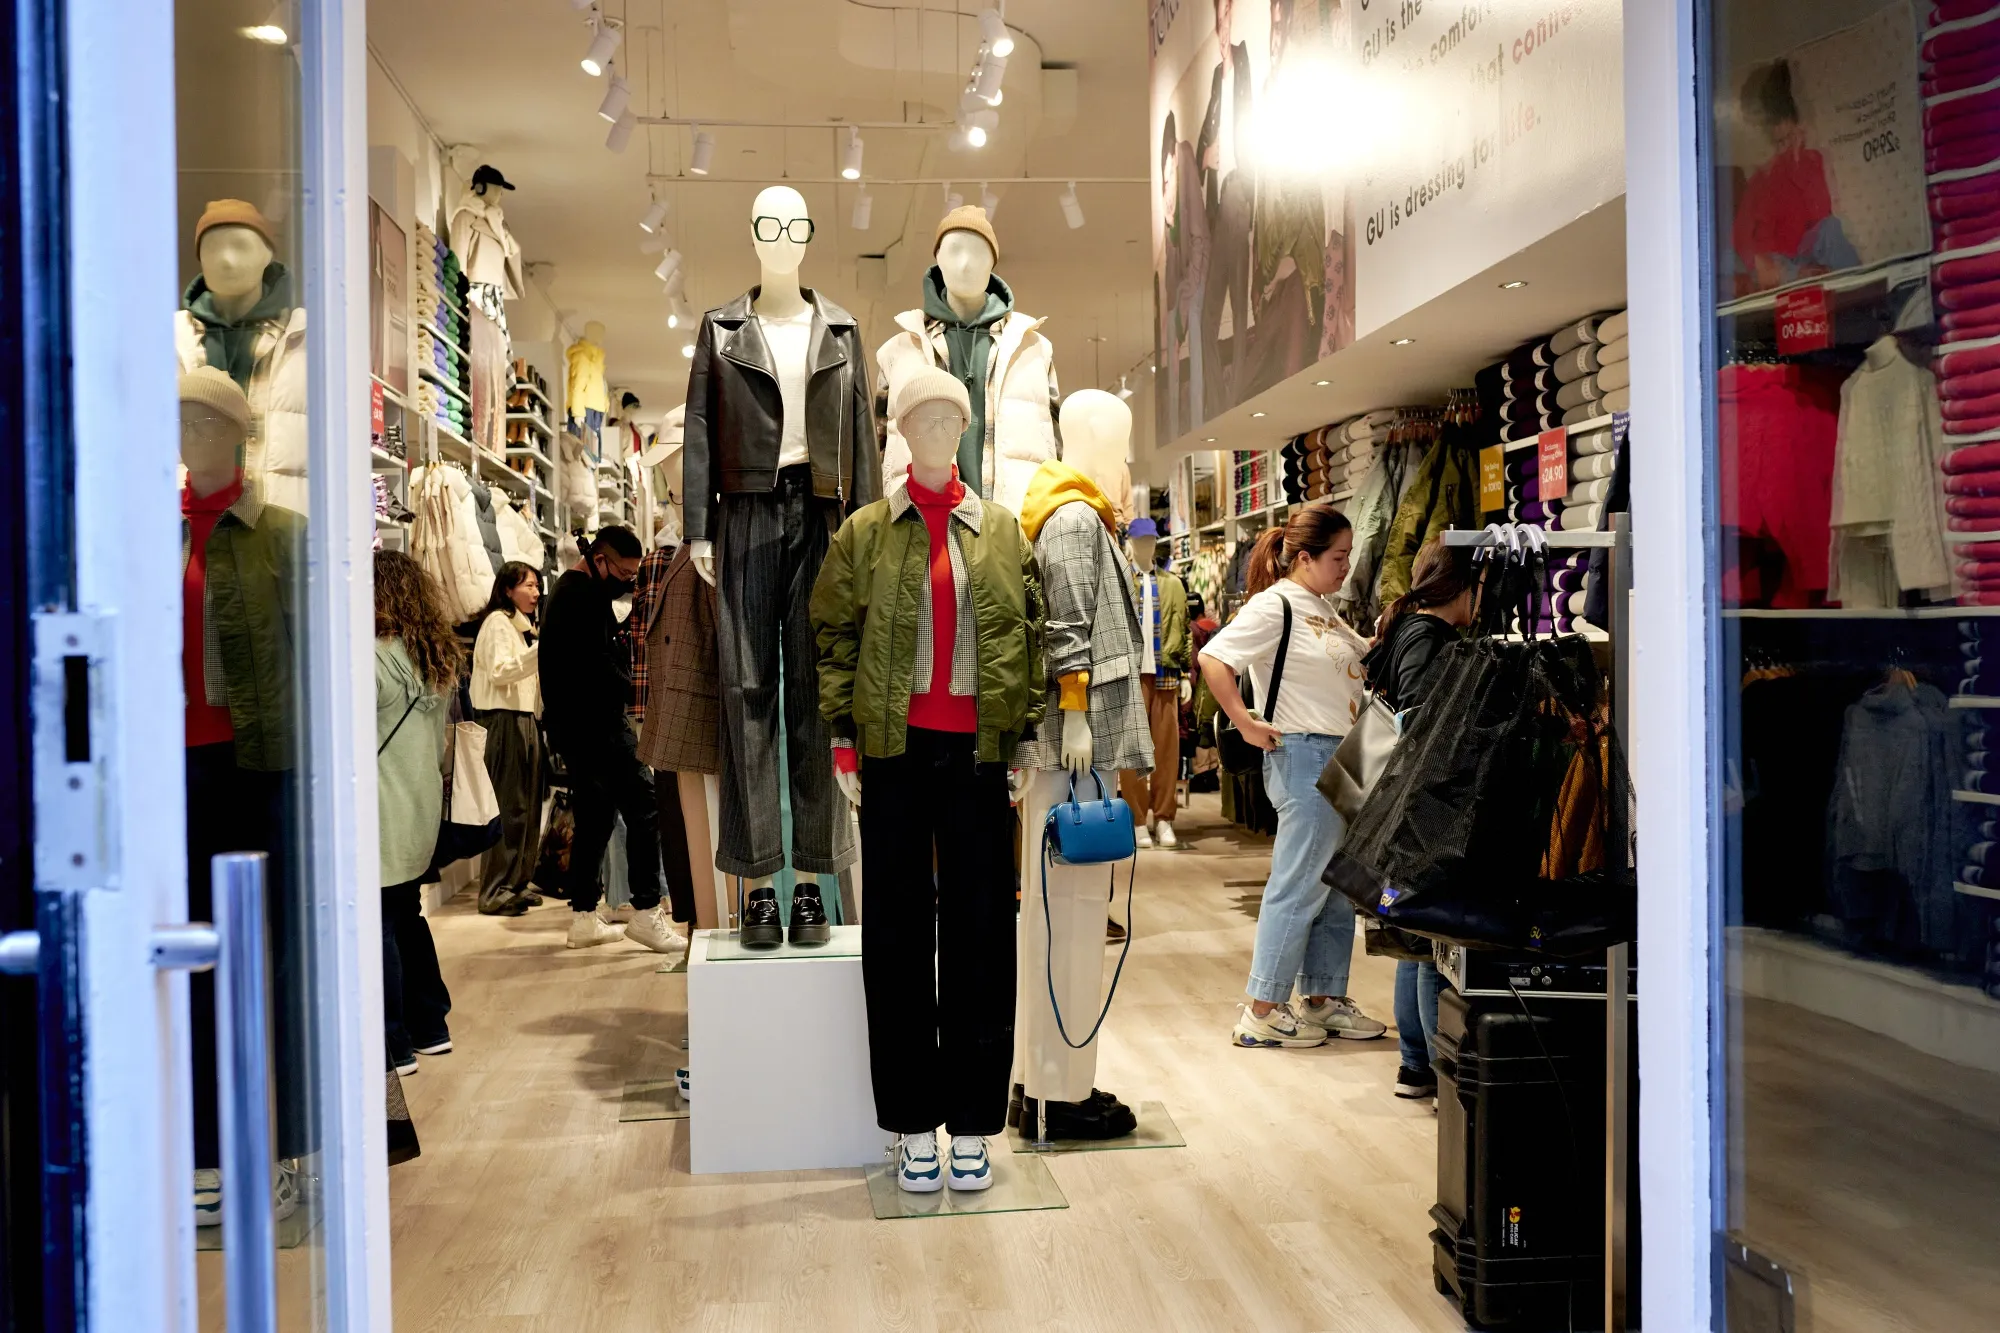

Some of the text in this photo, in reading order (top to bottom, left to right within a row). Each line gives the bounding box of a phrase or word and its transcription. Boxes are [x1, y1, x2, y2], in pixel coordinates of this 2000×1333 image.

[1363, 28, 1380, 66] GU
[1386, 18, 1396, 47] is
[1401, 0, 1422, 30] the
[1367, 208, 1384, 245] GU
[1390, 201, 1400, 229] is
[1405, 158, 1465, 217] dressing
[1380, 893, 1395, 907] GU
